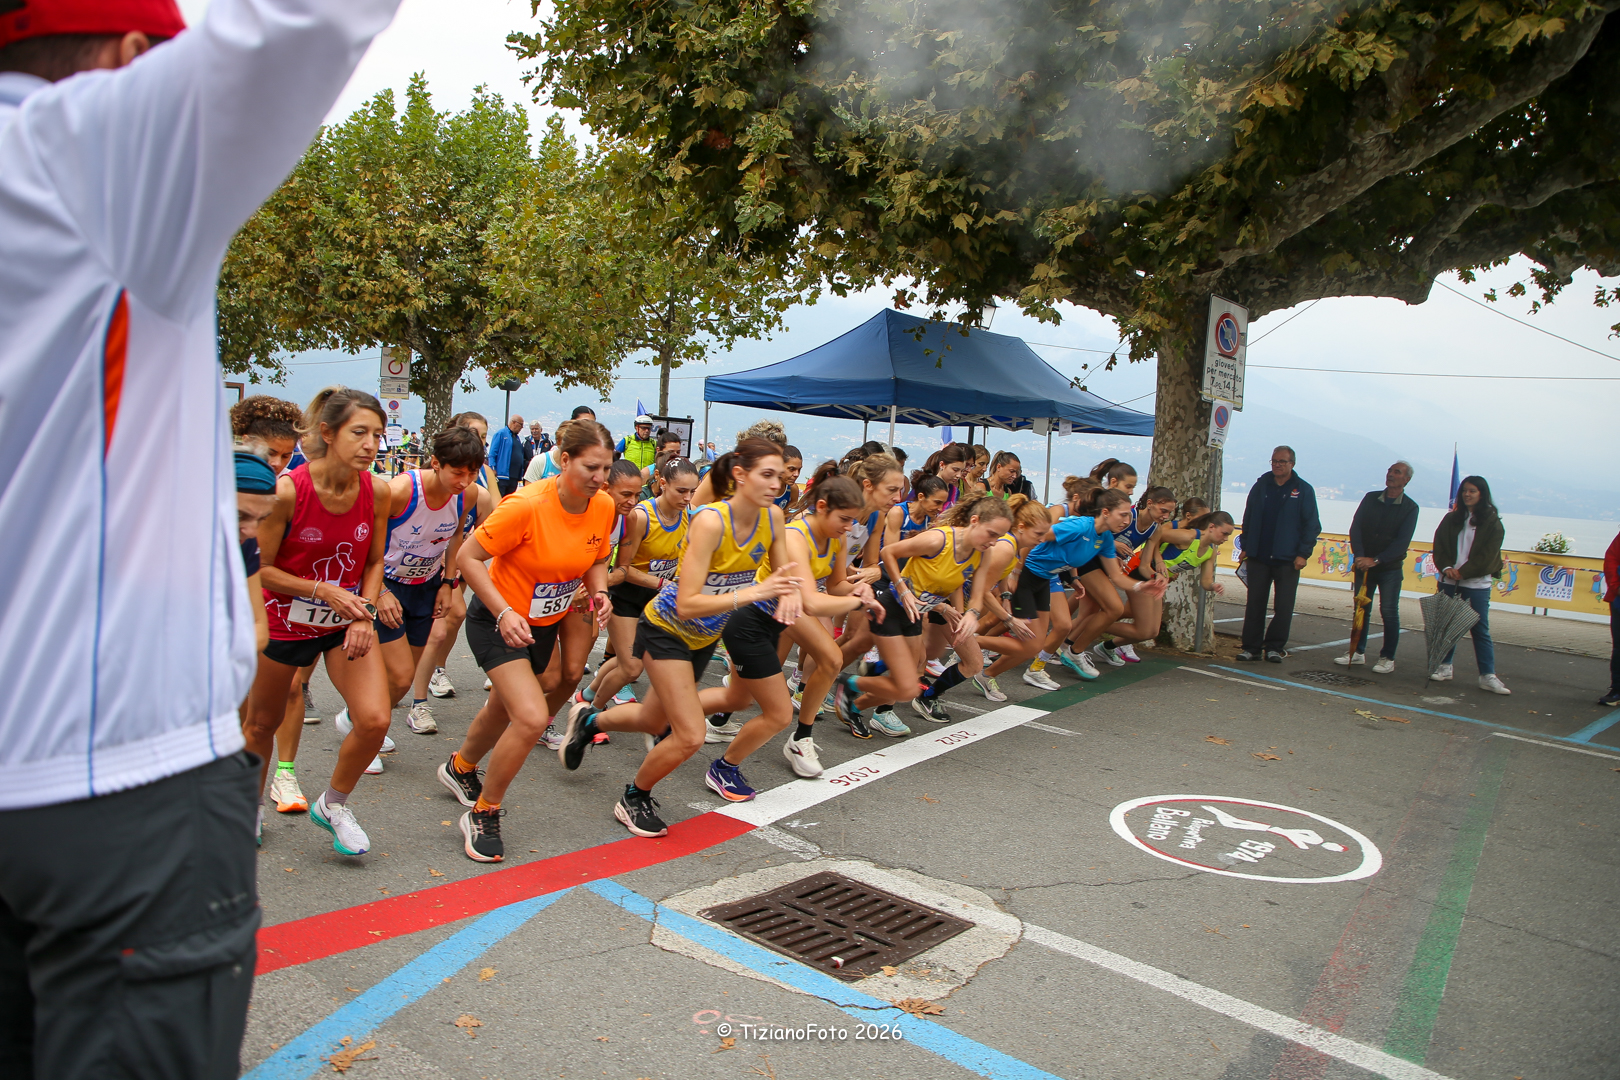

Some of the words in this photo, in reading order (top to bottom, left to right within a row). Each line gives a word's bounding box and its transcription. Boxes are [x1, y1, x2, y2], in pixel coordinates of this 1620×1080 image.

[1206, 366, 1217, 375] per
[1218, 370, 1242, 383] mercato
[542, 594, 572, 615] 587
[829, 766, 880, 786] 2026
[1146, 807, 1191, 841] Bellano
[1225, 839, 1276, 863] 1974
